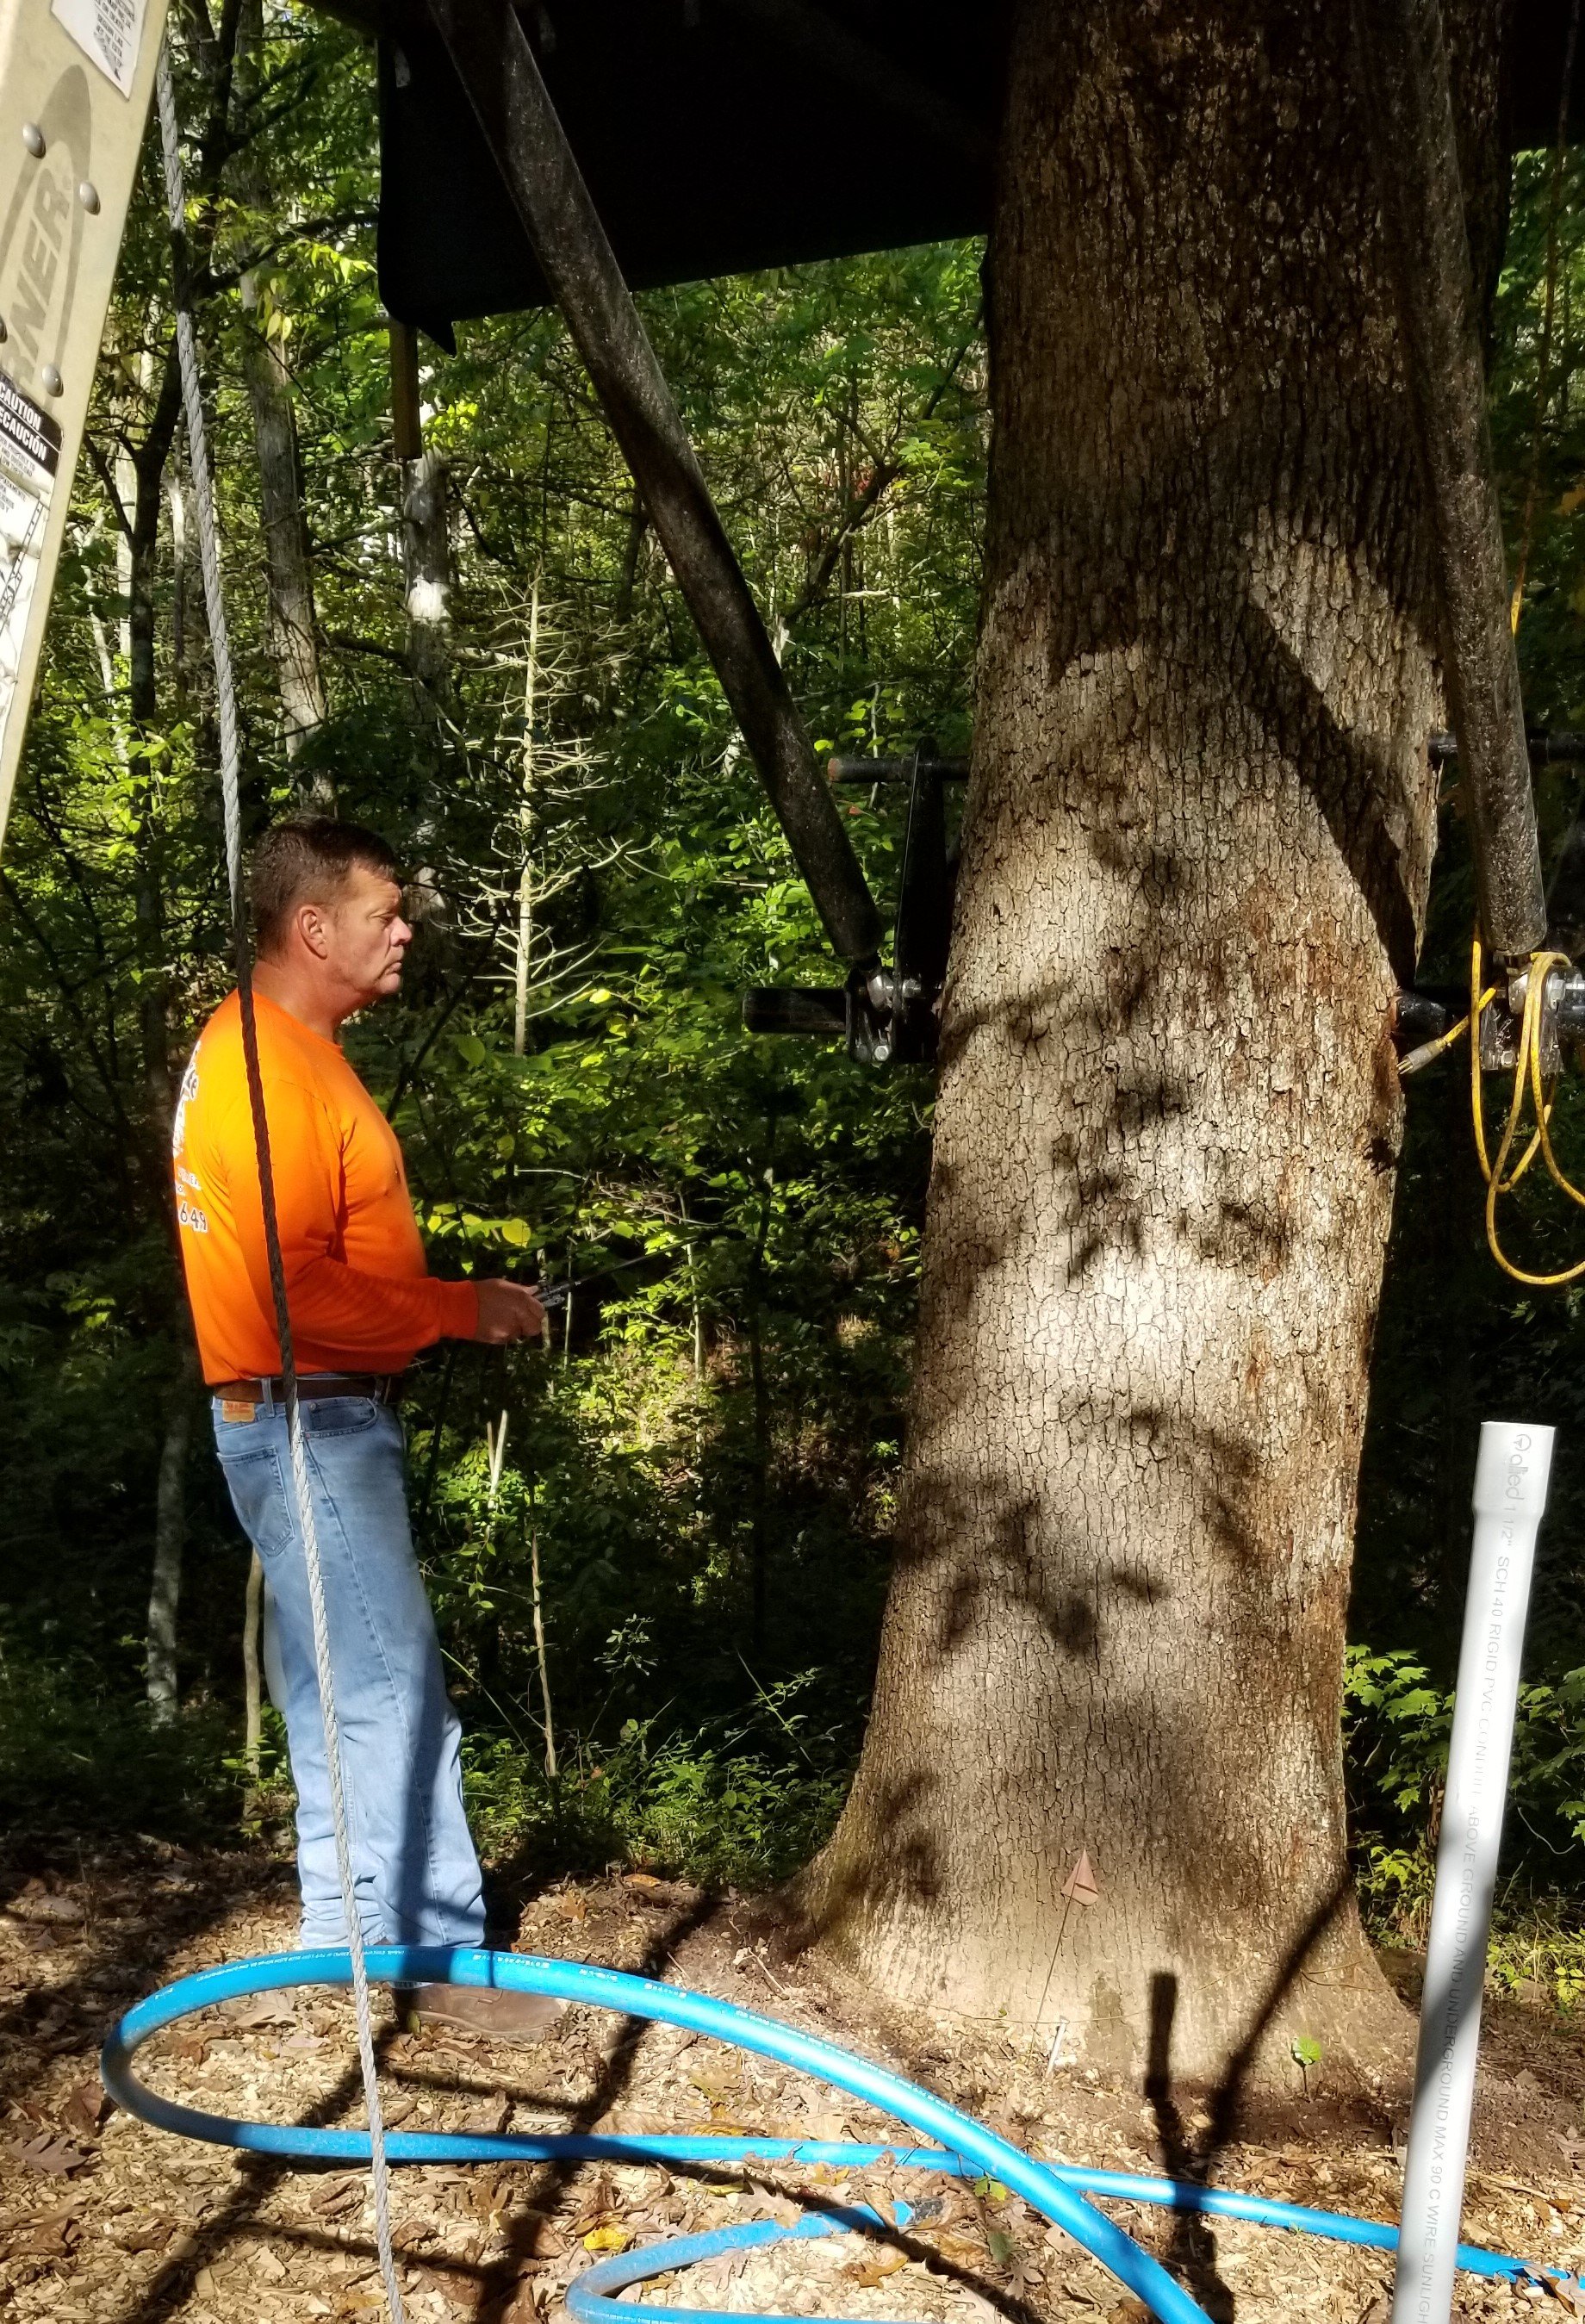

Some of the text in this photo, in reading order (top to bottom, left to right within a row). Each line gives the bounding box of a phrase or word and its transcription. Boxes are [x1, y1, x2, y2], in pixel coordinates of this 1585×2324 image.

[0, 384, 41, 431] CAUTION
[1505, 1454, 1529, 1501] allied
[1494, 1557, 1509, 1593] SCH
[1491, 1598, 1504, 1617] 40
[1485, 1624, 1501, 1672] RIGID
[1481, 1677, 1495, 1712] PVC
[1464, 1805, 1481, 1862] ABOVE
[1455, 1869, 1474, 1944] GROUND
[1451, 1947, 1465, 1982] AND
[1437, 1988, 1462, 2121] UNDERGROUND
[1432, 2126, 1447, 2160] MAX
[1429, 2189, 1440, 2201] C
[1431, 2166, 1443, 2184] 90
[1424, 2206, 1439, 2248] WIRE
[1418, 2253, 1434, 2324] SUNLIGH
